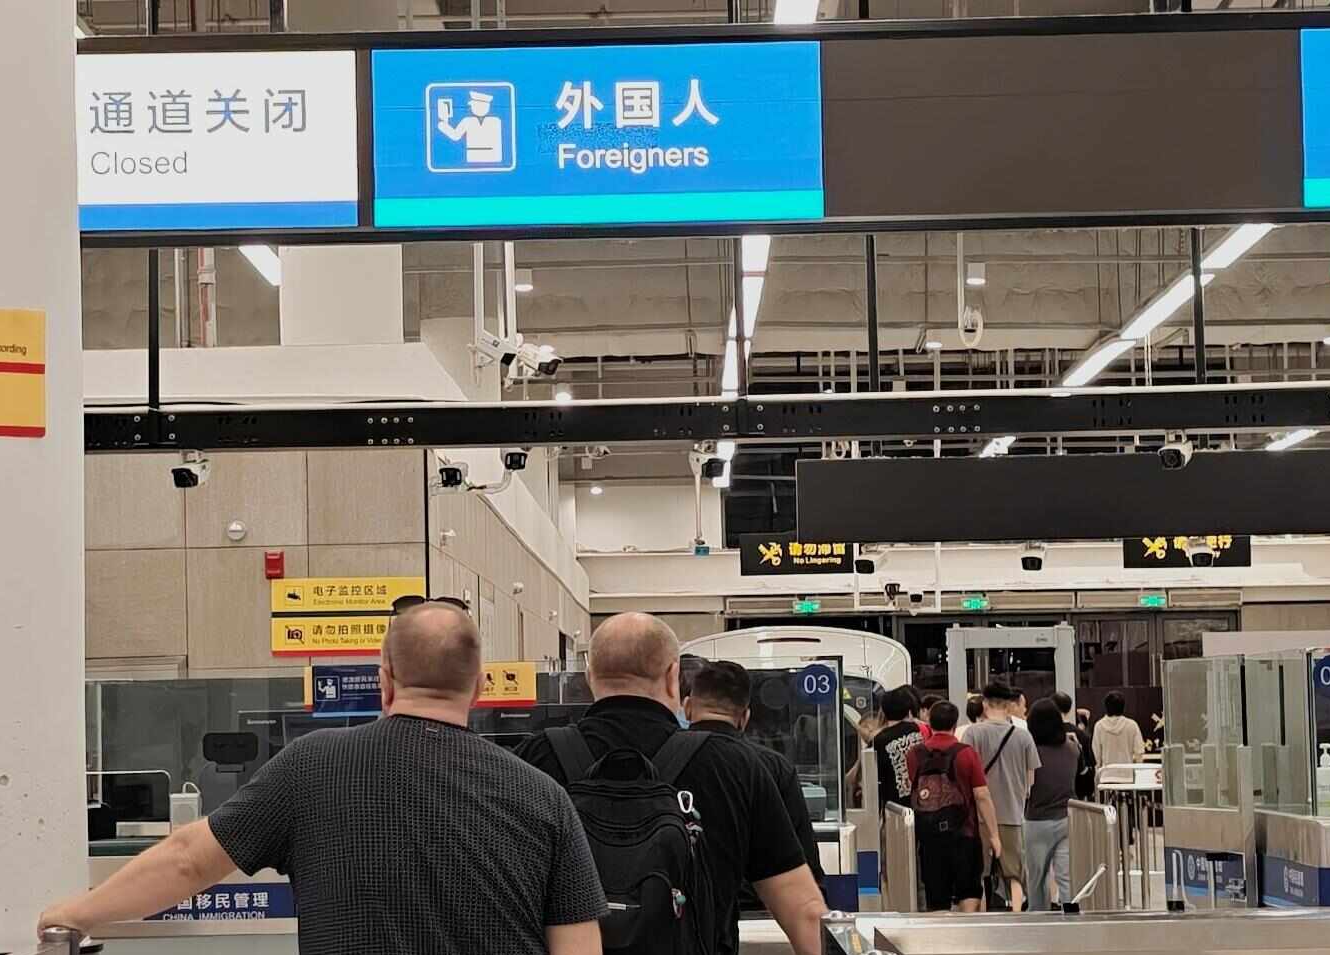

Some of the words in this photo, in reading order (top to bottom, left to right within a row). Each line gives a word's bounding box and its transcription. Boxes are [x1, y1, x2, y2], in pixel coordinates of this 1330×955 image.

[89, 89, 307, 135] 通道关闭
[555, 78, 719, 129] 外国人
[91, 151, 188, 175] Closed
[558, 143, 710, 174] Foreigners
[312, 584, 388, 597] 电子监控区域
[803, 674, 830, 694] 03
